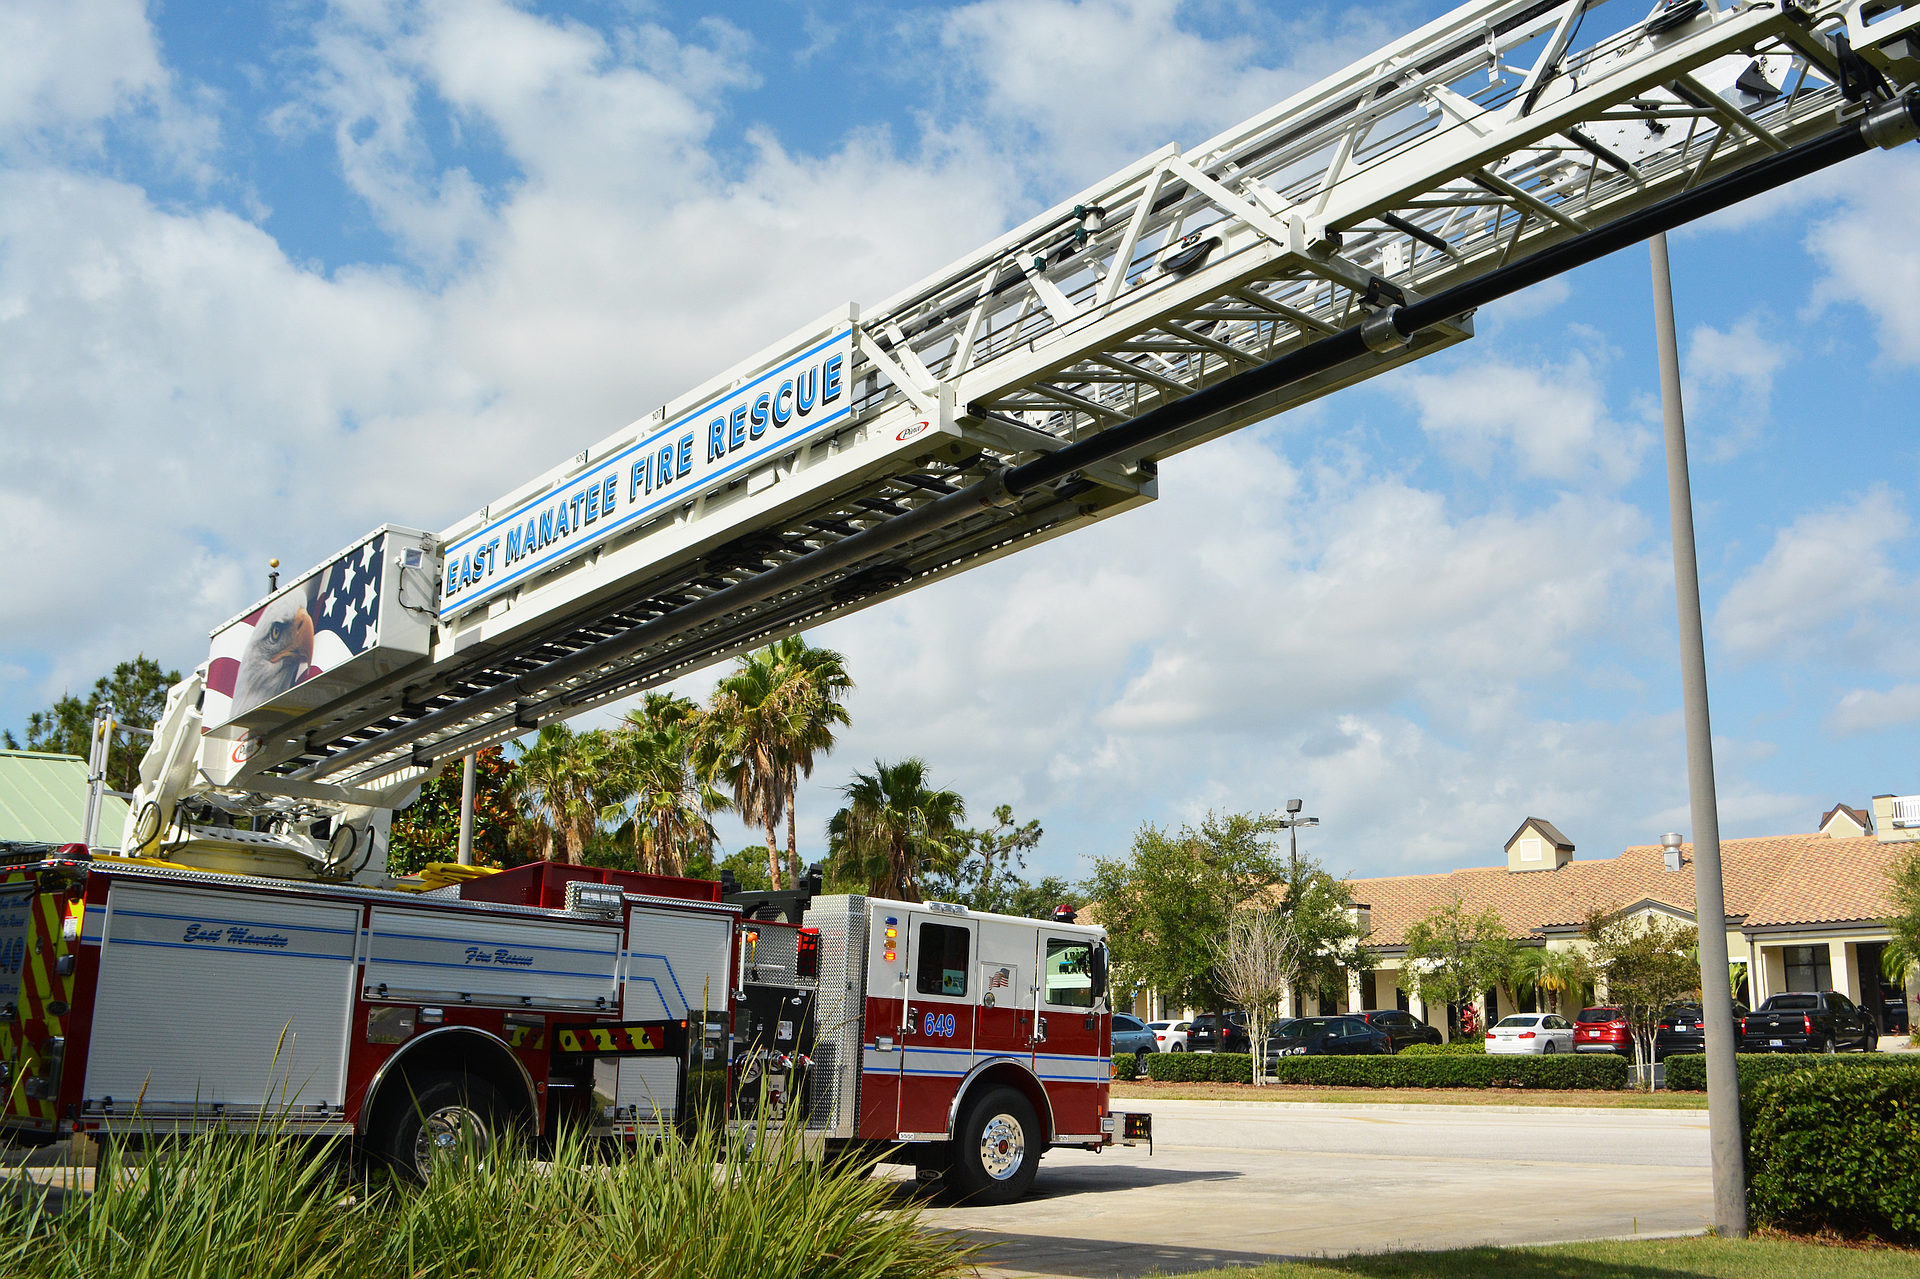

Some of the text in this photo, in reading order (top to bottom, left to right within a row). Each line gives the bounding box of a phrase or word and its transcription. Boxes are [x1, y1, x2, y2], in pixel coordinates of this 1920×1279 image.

[651, 408, 662, 421] 107
[575, 452, 586, 464] 100
[446, 352, 843, 598] EAST MANATEE FIRE RESCUE
[183, 923, 289, 948] East Manatee
[0, 937, 24, 975] 49
[465, 946, 534, 966] Fire Rescue
[924, 1012, 955, 1037] 649
